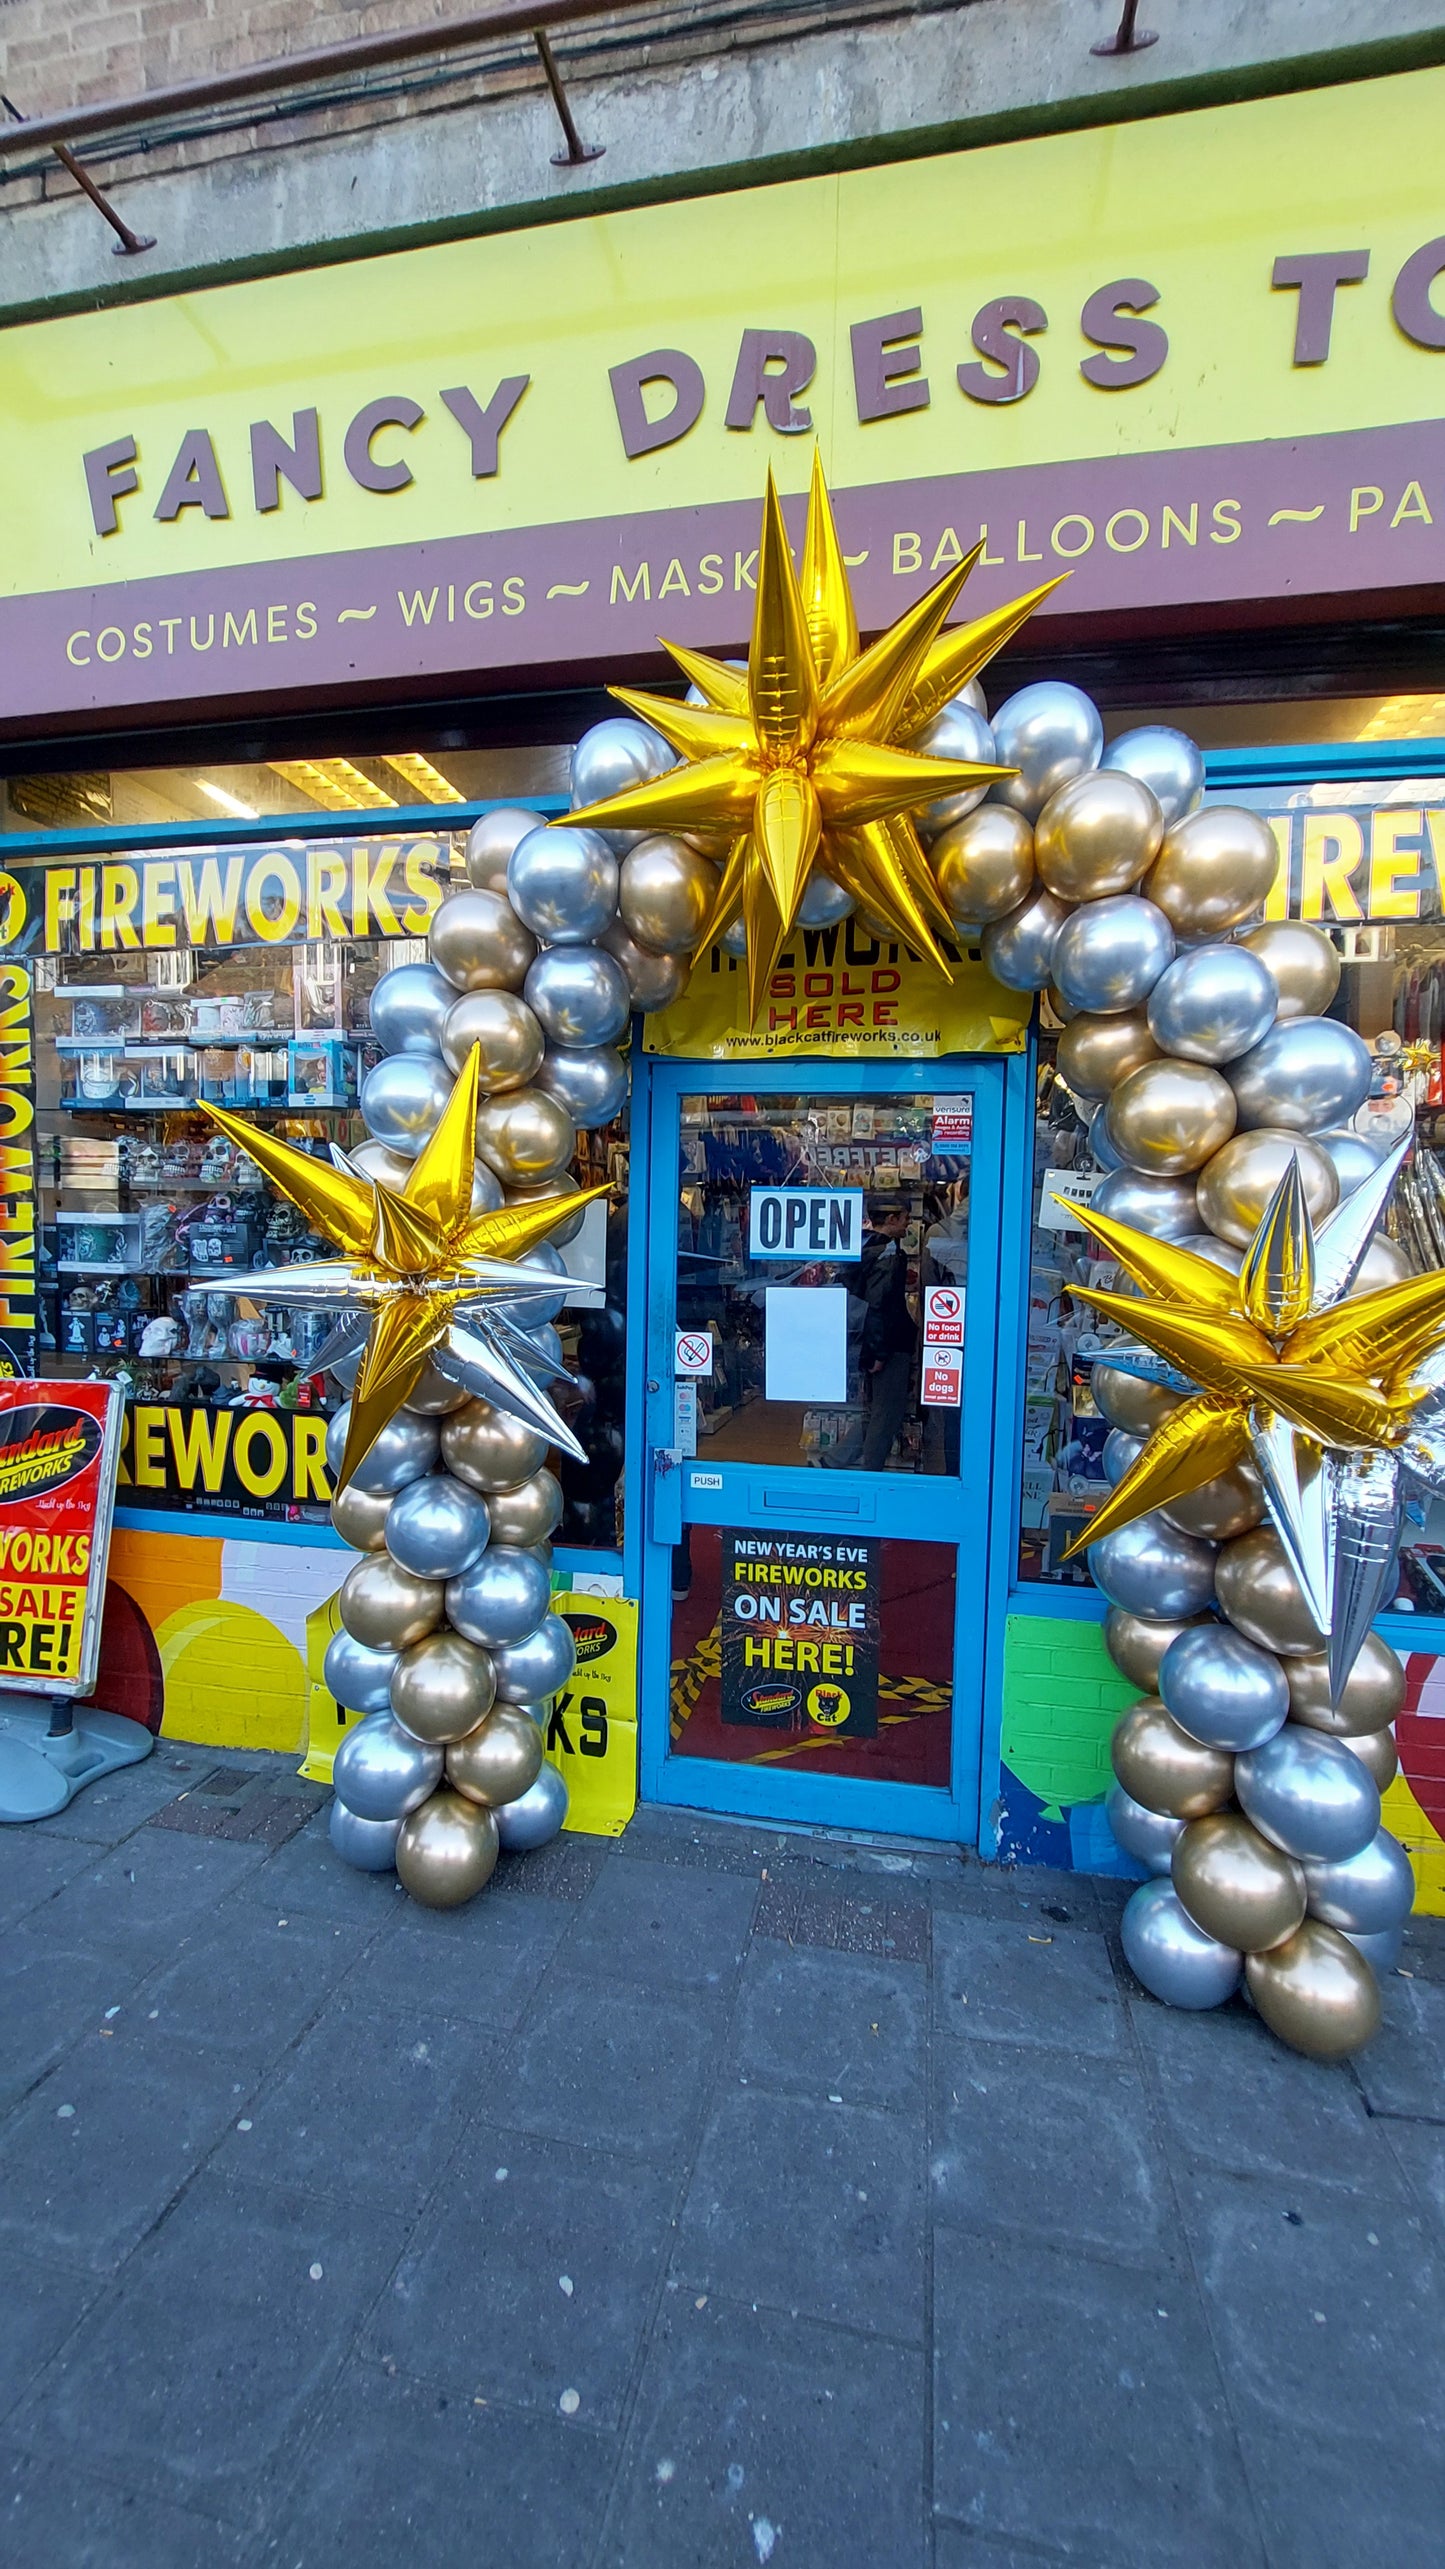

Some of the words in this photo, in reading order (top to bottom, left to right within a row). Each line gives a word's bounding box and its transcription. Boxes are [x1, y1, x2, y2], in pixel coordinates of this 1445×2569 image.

[83, 373, 531, 537] FANCY
[607, 277, 1170, 459] DRESS
[65, 601, 318, 667] COSTUMES
[398, 576, 526, 627] WIGS
[608, 547, 797, 606] MASK
[891, 499, 1243, 575] BALLOONS
[1349, 480, 1433, 533] PA
[1264, 807, 1445, 923] IRE
[43, 843, 448, 953] FIREWORKS
[769, 969, 901, 998] SOLD
[768, 1000, 899, 1031] HERE
[725, 1029, 942, 1048] www.blackcatfireworks.co.uk
[935, 1116, 970, 1125] Alarm
[759, 1197, 852, 1251] OPEN
[928, 1323, 940, 1331] No
[941, 1324, 961, 1332] food
[939, 1333, 960, 1341] drink
[928, 1382, 954, 1394] dogs
[934, 1371, 949, 1381] No
[694, 1476, 721, 1487] PUSH
[734, 1540, 772, 1556] NEW
[774, 1542, 832, 1561] YEAR'S
[836, 1547, 868, 1563] EVE
[734, 1562, 867, 1590] FIREWORKS
[0, 1586, 77, 1621] SALE
[734, 1594, 780, 1622] ON
[789, 1598, 866, 1629] SALE
[0, 1621, 72, 1674] RE!
[744, 1636, 855, 1677] HERE!
[815, 1689, 843, 1700] Black
[816, 1713, 838, 1723] Cat
